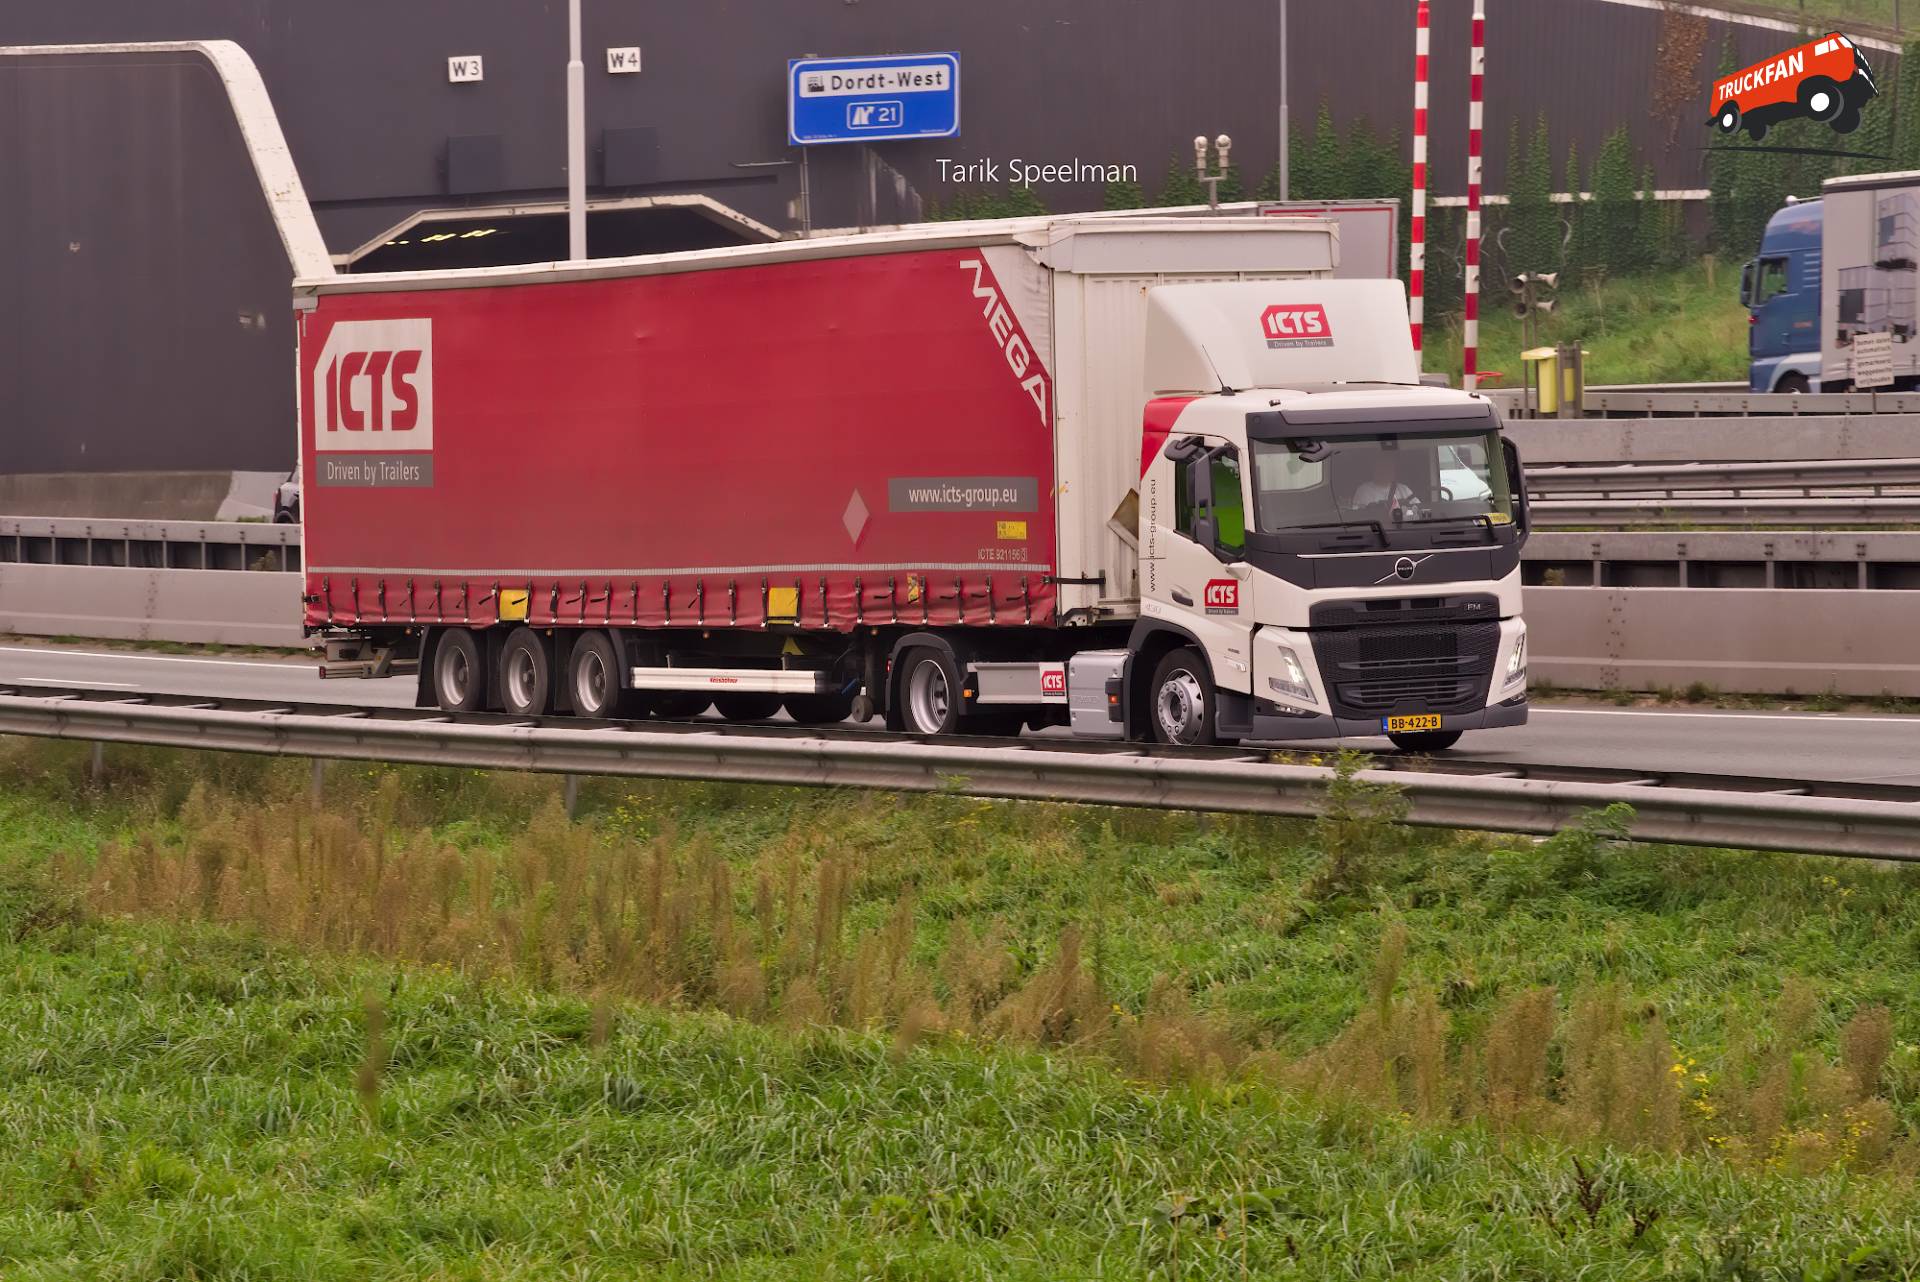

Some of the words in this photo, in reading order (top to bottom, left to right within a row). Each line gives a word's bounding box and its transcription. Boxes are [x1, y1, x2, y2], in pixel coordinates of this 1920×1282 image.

[831, 71, 942, 90] Dordt-West
[878, 107, 896, 121] 21
[1267, 311, 1322, 334] ICTS
[960, 260, 1047, 428] MEGA
[326, 350, 422, 431] ICTS
[327, 462, 360, 480] Driven
[364, 462, 376, 486] by
[380, 461, 420, 481] Trailers
[909, 484, 1017, 507] www.icts-group.eu
[1208, 585, 1235, 603] ICTS
[1043, 675, 1063, 689] ICTS
[1391, 716, 1438, 729] BB-422-B
